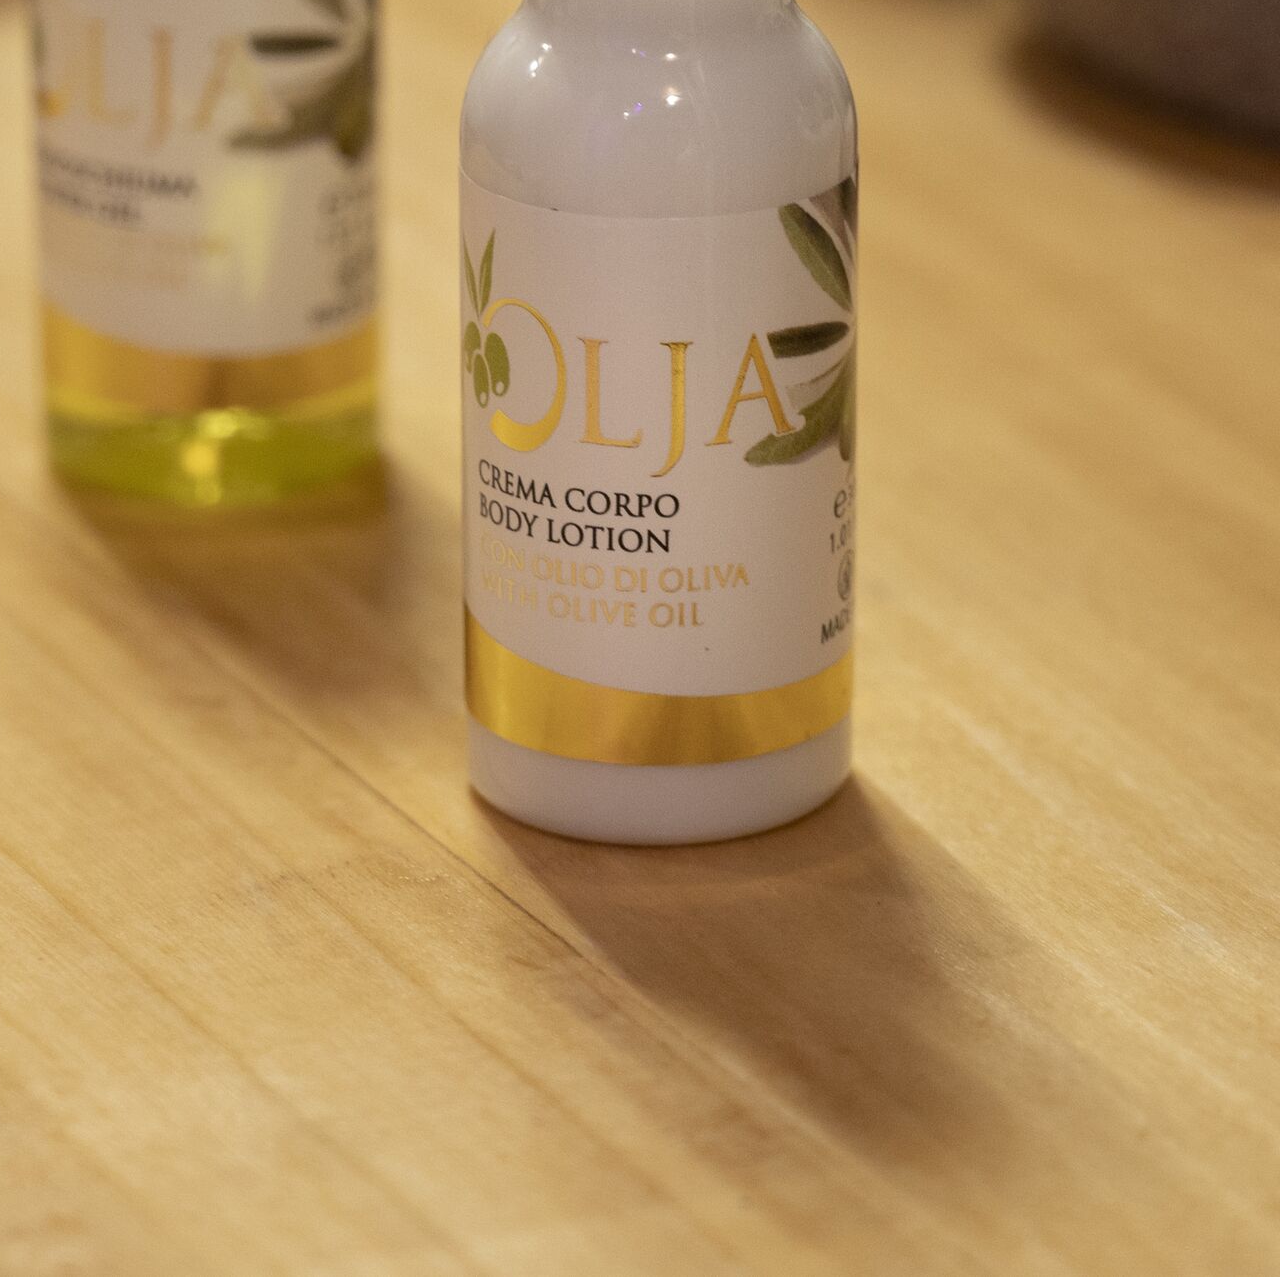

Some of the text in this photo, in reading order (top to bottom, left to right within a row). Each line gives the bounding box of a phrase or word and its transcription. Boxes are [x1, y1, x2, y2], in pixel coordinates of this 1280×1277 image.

[482, 297, 798, 478] OLJA
[478, 458, 680, 518] CREMA CORPO
[478, 491, 671, 554] BODY LOTION
[480, 570, 705, 629] WITH OLIVE OIL
[530, 554, 605, 591] OLIO
[614, 565, 648, 594] DI
[657, 562, 751, 594] OLIVA
